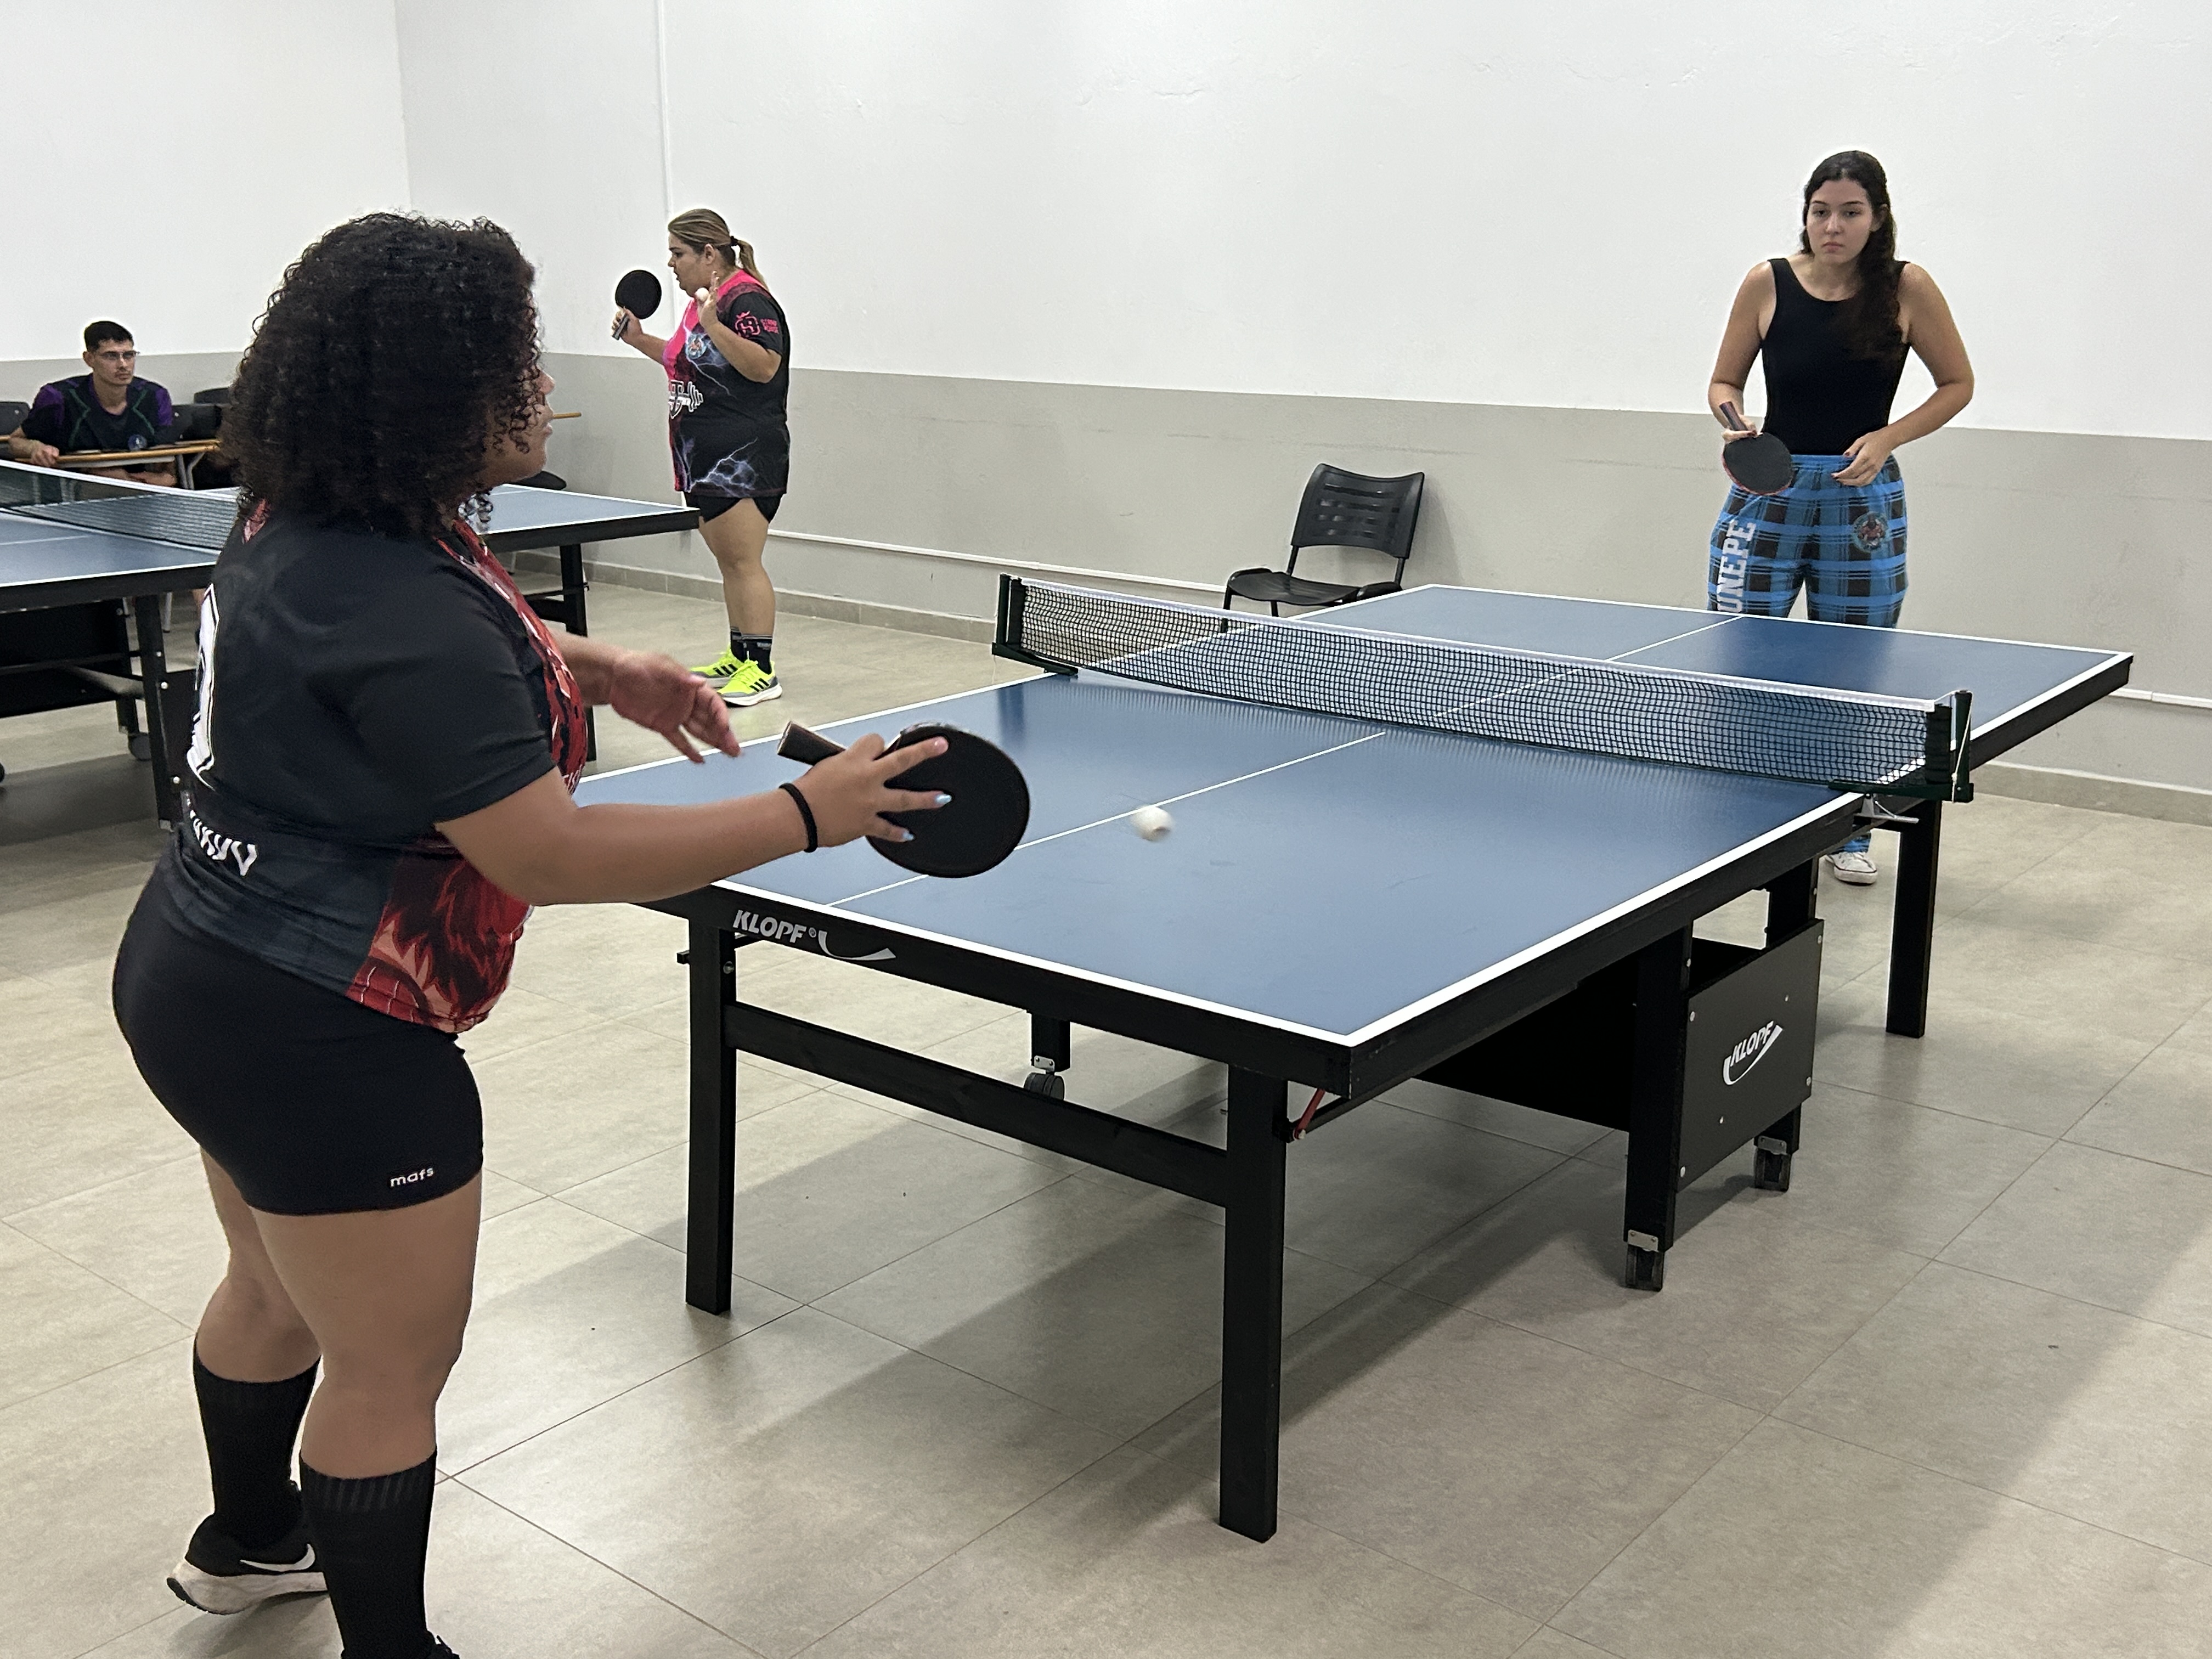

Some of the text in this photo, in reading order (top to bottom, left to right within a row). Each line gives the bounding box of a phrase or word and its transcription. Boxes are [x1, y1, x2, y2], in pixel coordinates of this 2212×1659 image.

[1717, 519, 1756, 613] UNEPE
[733, 909, 807, 944] KLOPF
[1730, 1020, 1774, 1067] KLOPF
[390, 1167, 434, 1187] mafs
